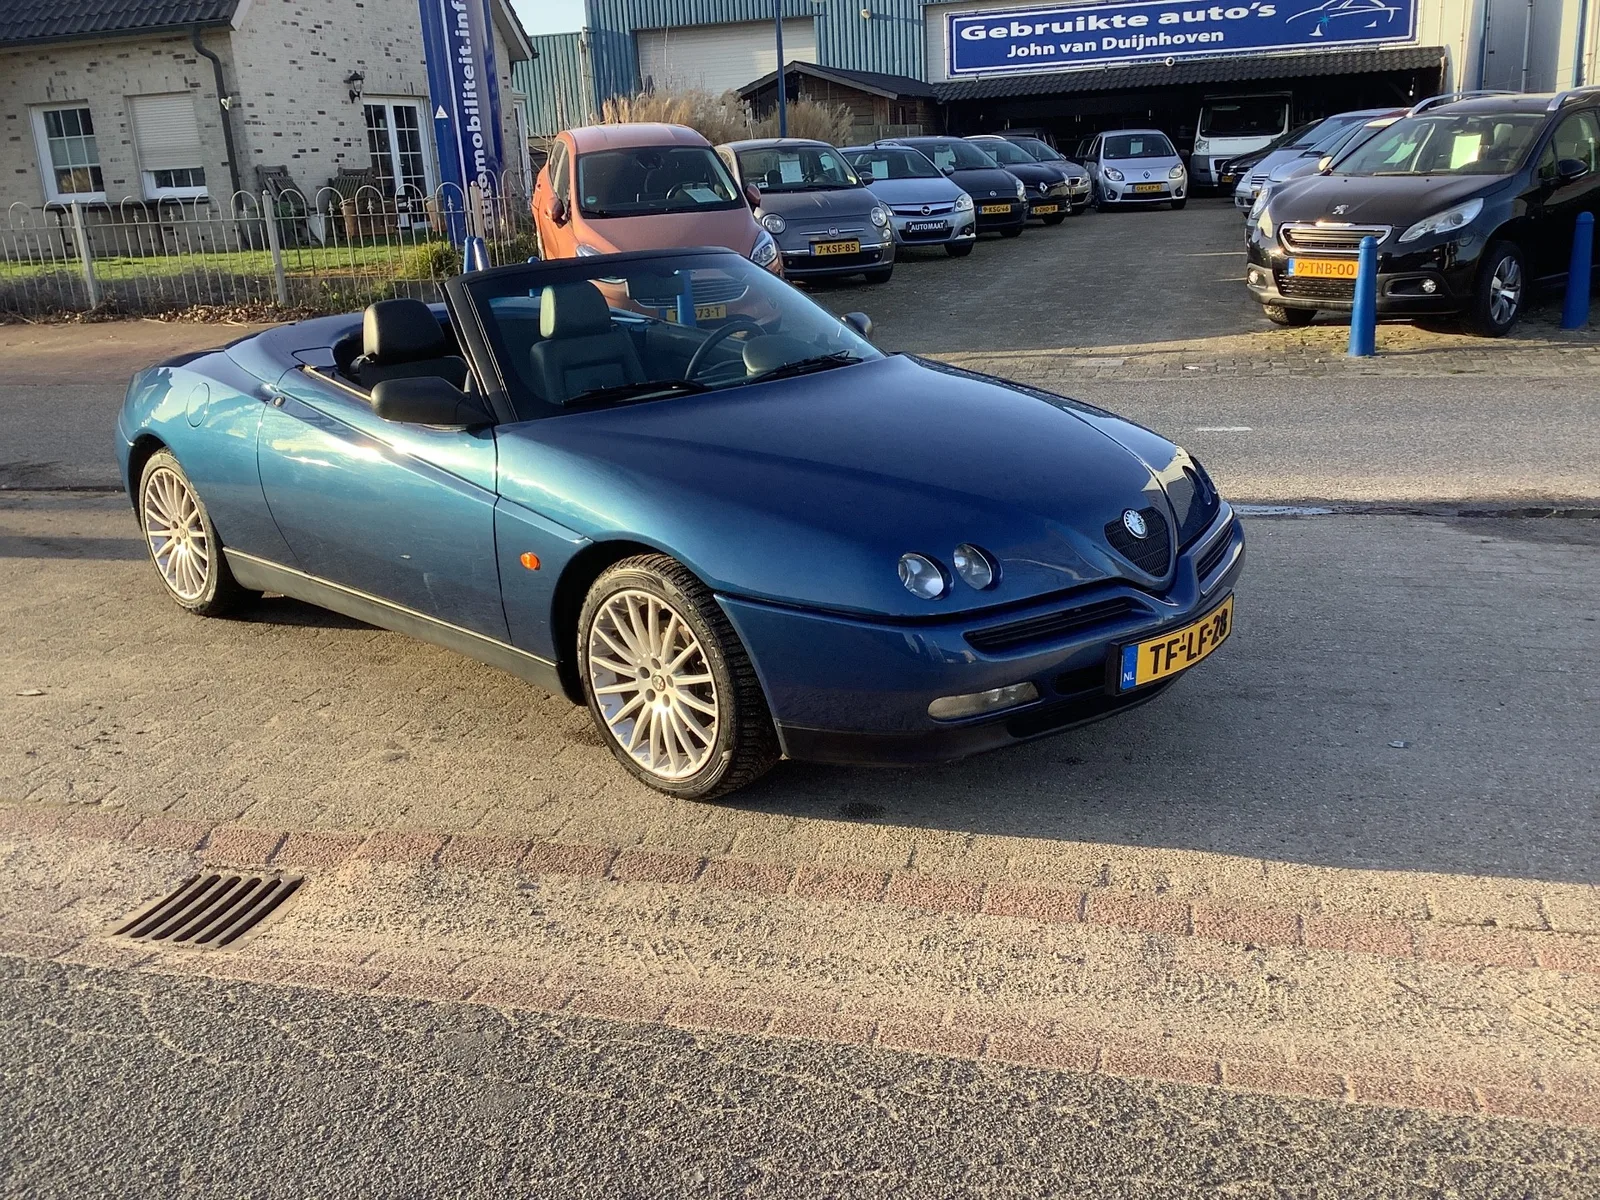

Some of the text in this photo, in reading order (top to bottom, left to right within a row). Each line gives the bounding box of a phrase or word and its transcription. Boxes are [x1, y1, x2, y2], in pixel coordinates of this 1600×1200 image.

[961, 2, 1277, 41] Gebruikte auto's
[1007, 31, 1225, 58] John van Duijnhoven
[451, 0, 493, 230] automobiliteit.inf
[911, 222, 944, 231] AUTOMAAT
[817, 243, 857, 255] 7-KSF-85
[1297, 262, 1355, 276] 9-TNB-00
[1149, 608, 1228, 675] TF-LF-28
[1123, 671, 1134, 682] NL
